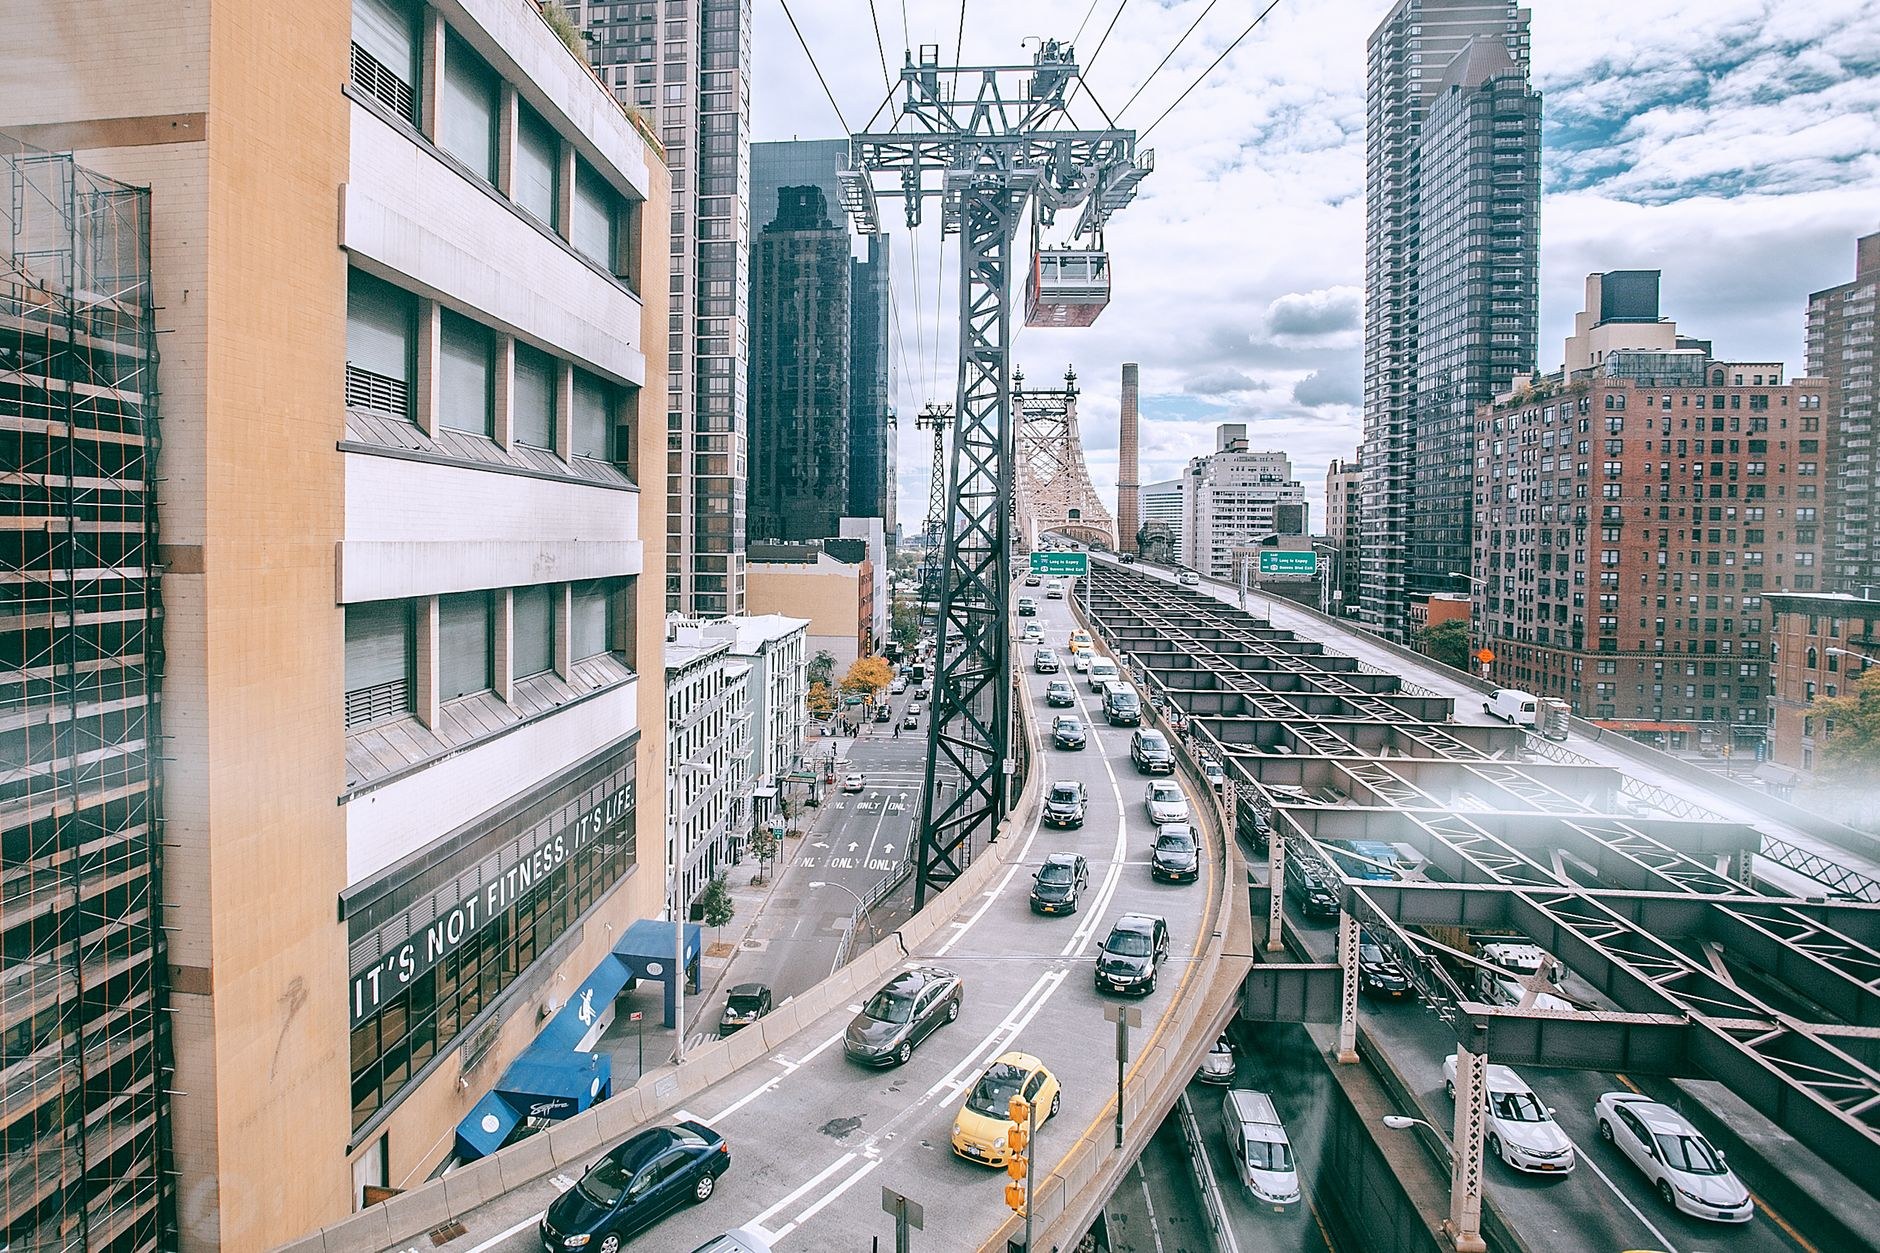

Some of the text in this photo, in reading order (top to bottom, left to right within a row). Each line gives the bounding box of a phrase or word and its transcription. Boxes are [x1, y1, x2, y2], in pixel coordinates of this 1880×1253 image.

[857, 802, 880, 810] ONLY
[869, 859, 899, 871] ONLY
[355, 784, 634, 1018] IT'S NOT FITNESS. IT'S LIFE.
